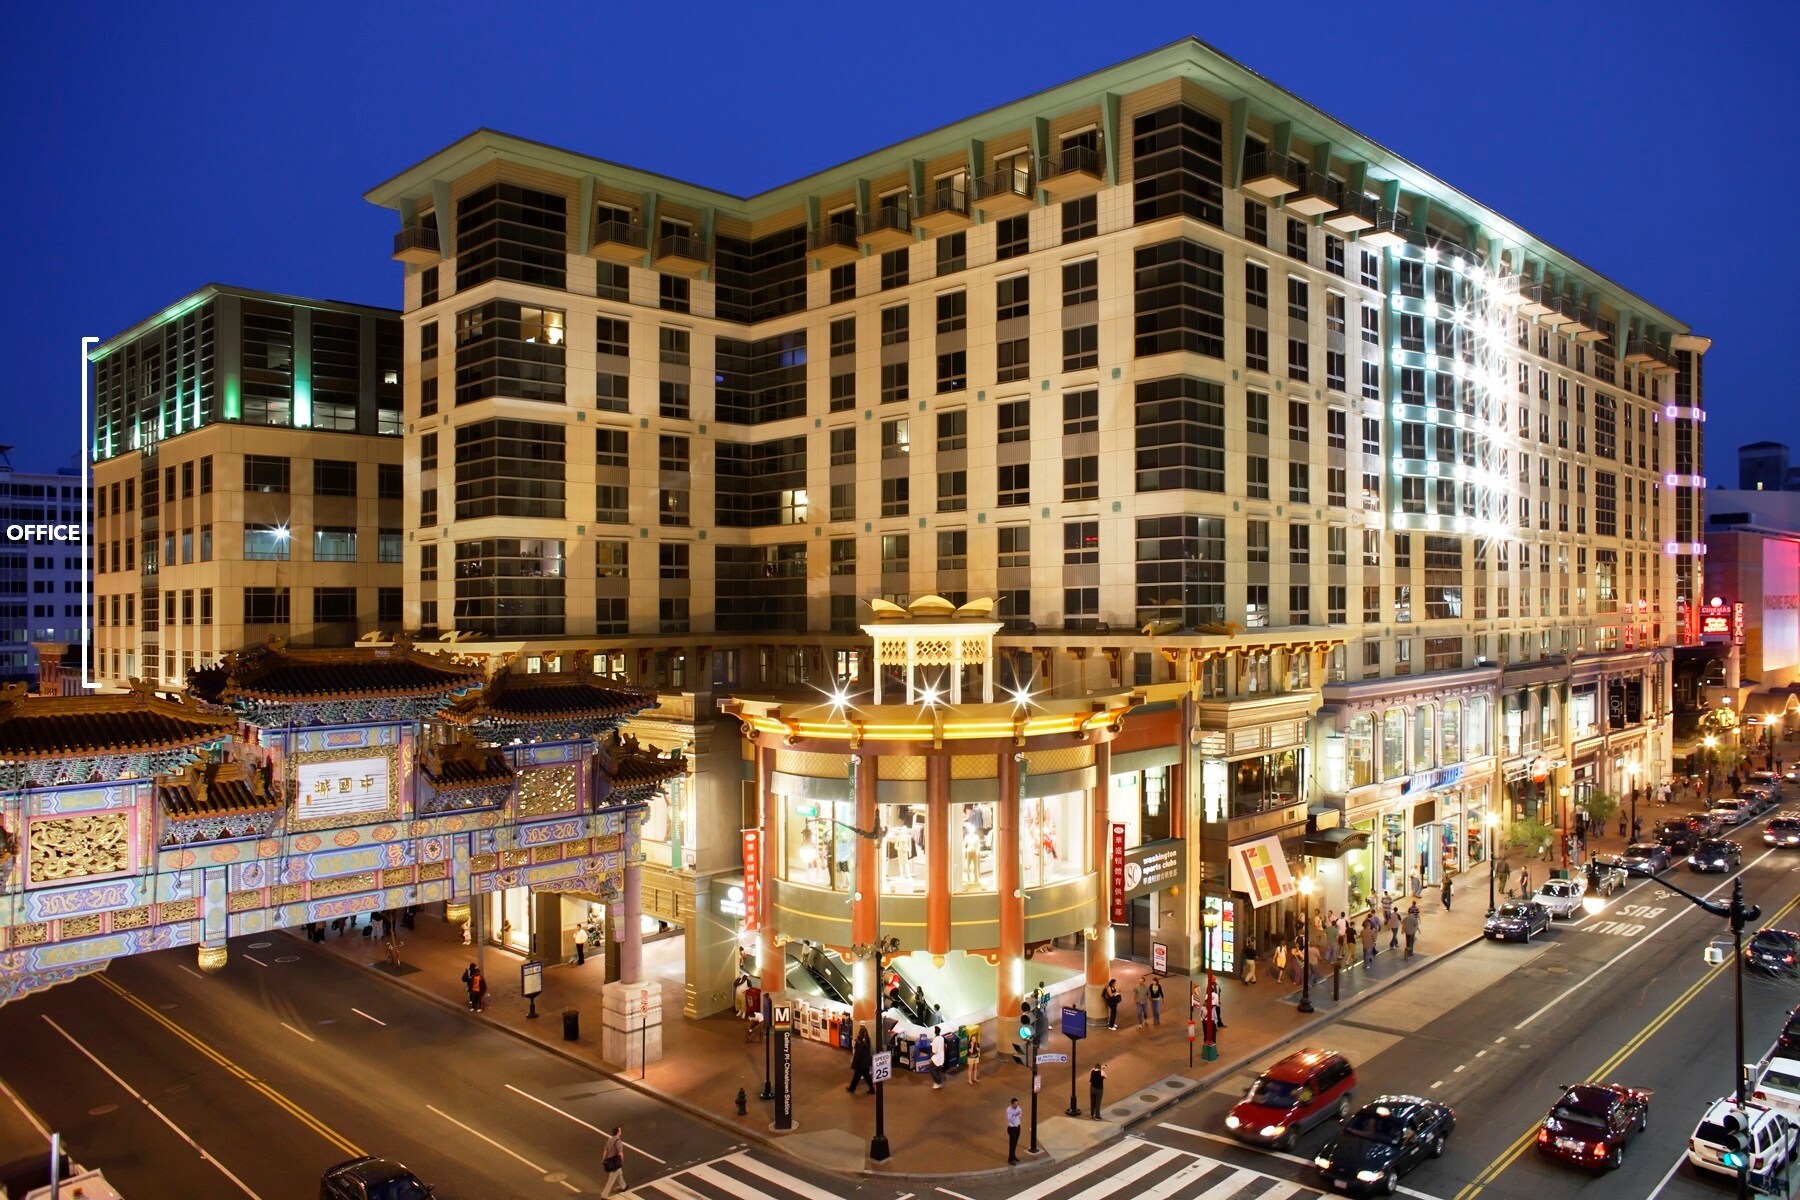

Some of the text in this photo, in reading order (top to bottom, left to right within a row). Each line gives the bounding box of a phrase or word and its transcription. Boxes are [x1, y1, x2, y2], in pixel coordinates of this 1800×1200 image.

[1701, 606, 1731, 614] CINEMAS
[1734, 602, 1744, 645] REGAL
[1610, 694, 1621, 720] LOFT
[1627, 690, 1637, 714] LOFT
[1142, 850, 1177, 865] washington
[1142, 859, 1177, 875] sports clubs
[1615, 904, 1667, 919] BUS
[1580, 920, 1646, 937] ONLY
[775, 1007, 790, 1022] M
[874, 1054, 889, 1063] SPEED
[875, 1067, 889, 1080] 25
